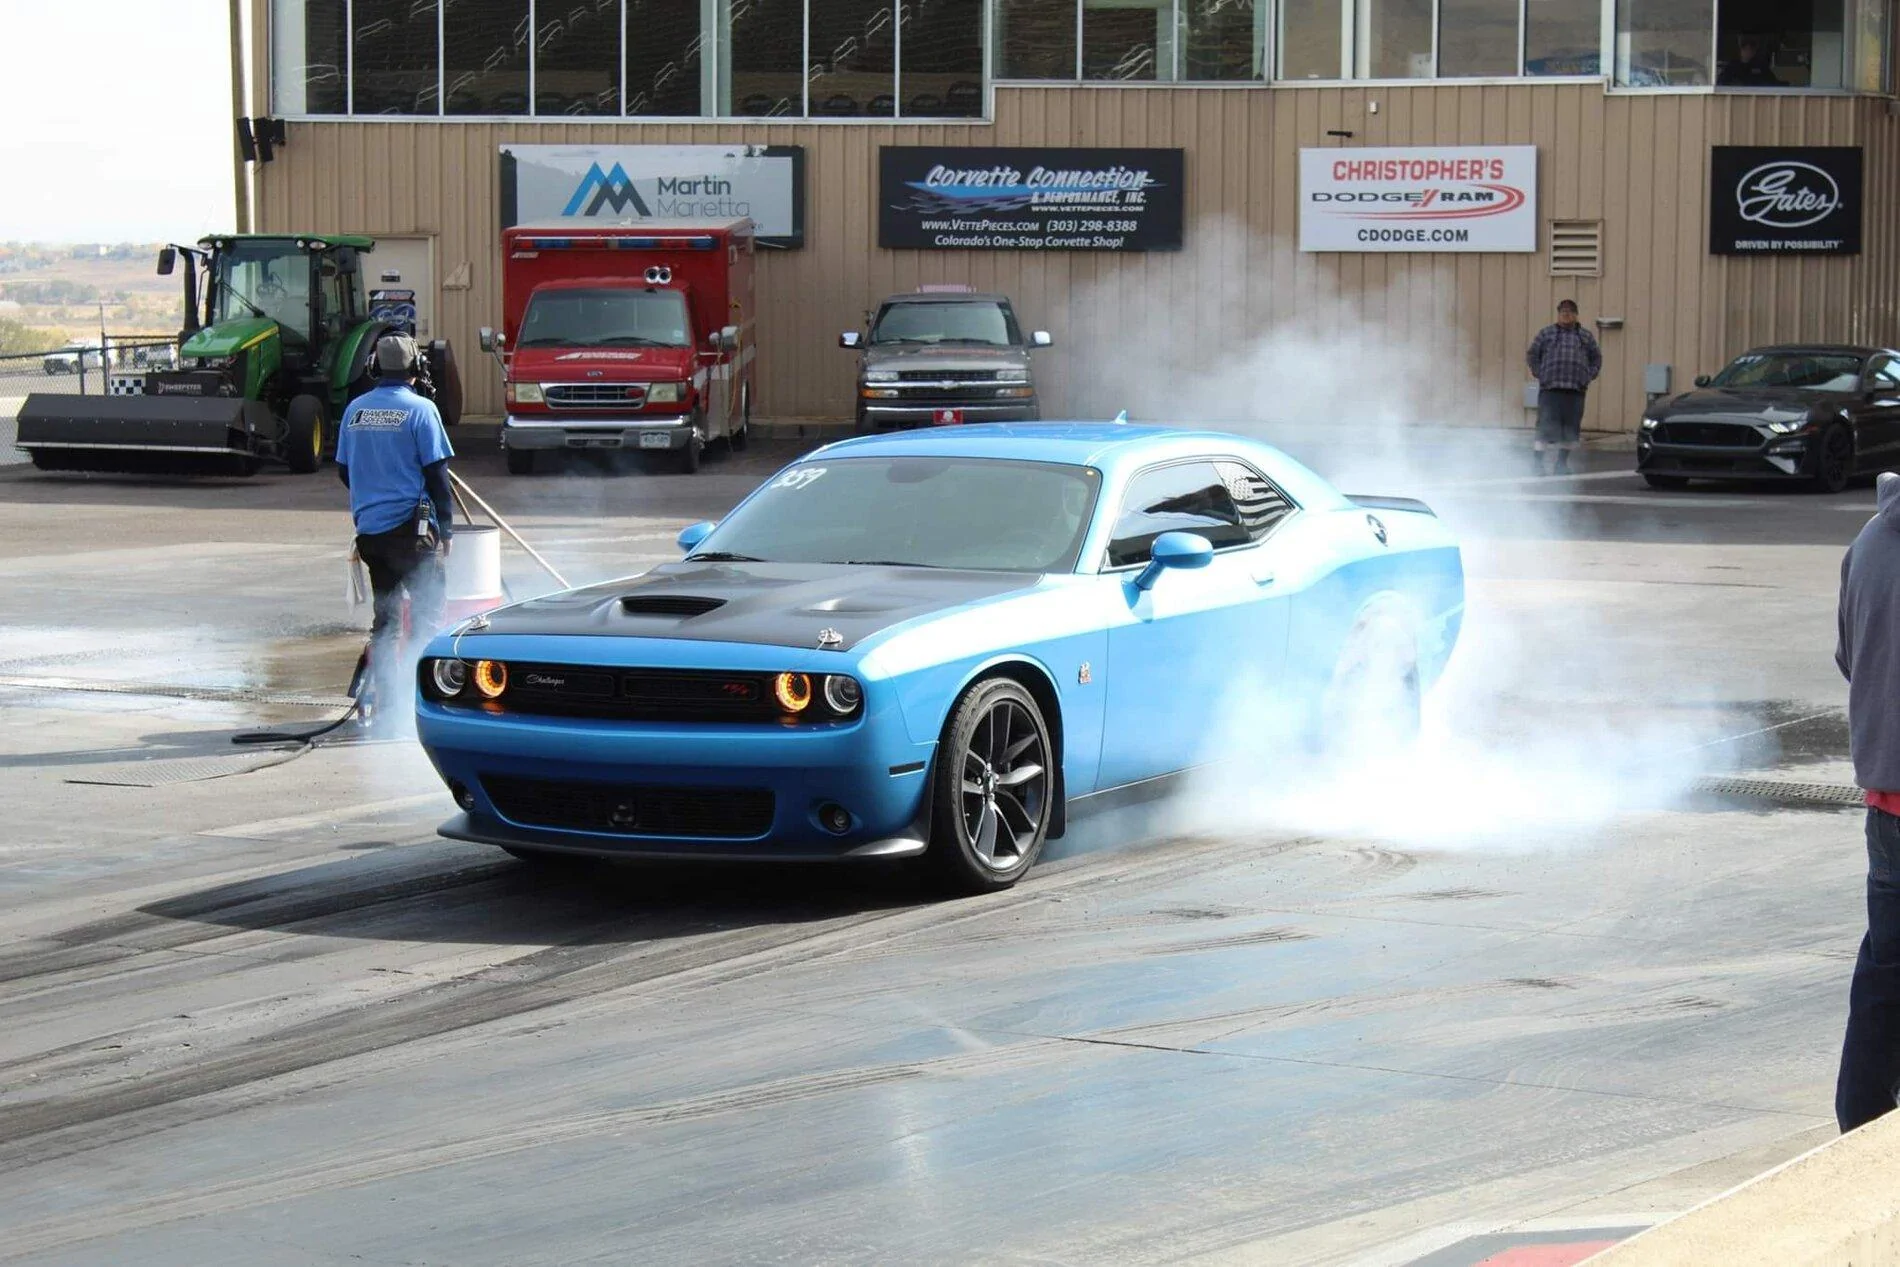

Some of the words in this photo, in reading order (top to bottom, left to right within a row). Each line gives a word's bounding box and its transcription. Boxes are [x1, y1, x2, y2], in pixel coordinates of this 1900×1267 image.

[926, 164, 1021, 187] Corvette
[1027, 166, 1148, 189] Connection
[1333, 159, 1504, 181] CHRISTOPHER'S
[657, 175, 731, 195] Martin
[1124, 191, 1147, 203] INC.
[1312, 192, 1423, 202] DODGE
[1440, 191, 1494, 202] RAM
[1743, 170, 1833, 218] Gates
[657, 199, 750, 218] Marietta
[1046, 219, 1078, 232] (303)
[1079, 220, 1138, 231] 298-8388
[934, 235, 991, 246] Colorado's
[992, 236, 1043, 249] One-Stop
[1045, 236, 1092, 247] Corvette
[1092, 236, 1124, 249] Shop!
[1357, 229, 1469, 242] CDODGE.COM
[1735, 240, 1769, 249] DRIVEN
[1771, 240, 1783, 249] BY
[1784, 240, 1840, 249] POSSIBILITY
